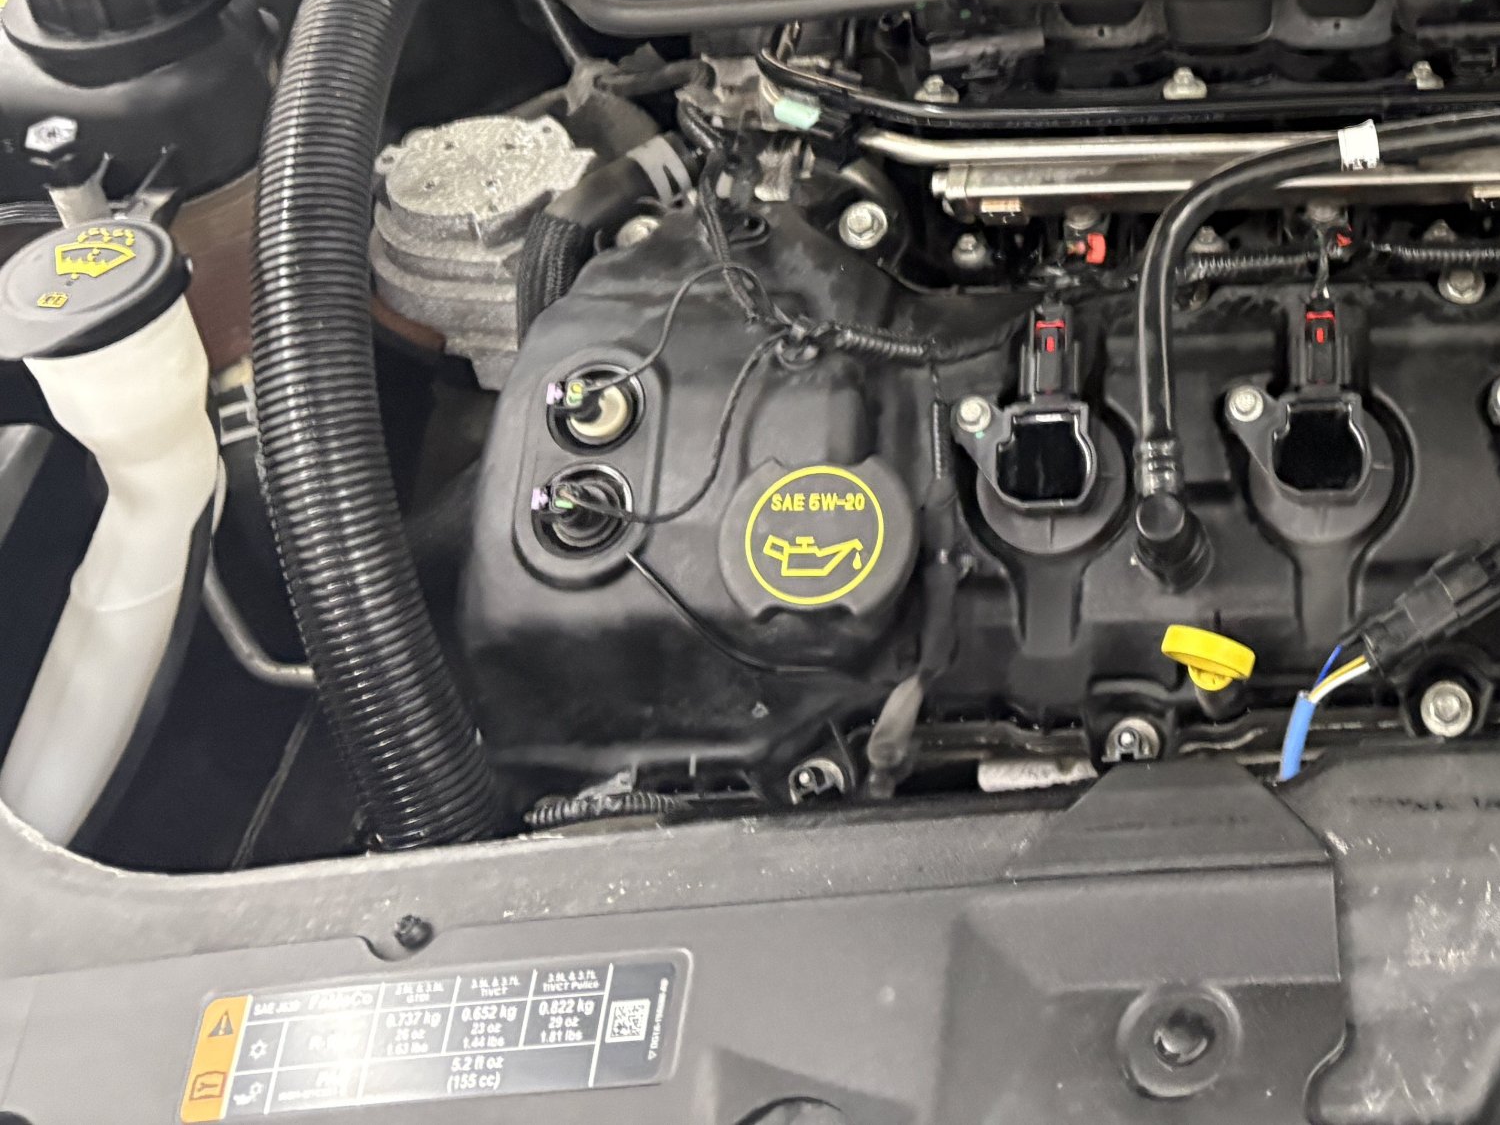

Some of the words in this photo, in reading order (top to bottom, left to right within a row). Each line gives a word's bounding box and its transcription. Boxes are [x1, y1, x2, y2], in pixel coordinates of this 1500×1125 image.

[770, 493, 806, 512] SAE
[809, 492, 866, 511] 5W-20
[461, 1007, 497, 1022] 0.652
[500, 1005, 518, 1021] kg
[539, 1001, 574, 1017] 0.822
[577, 998, 595, 1015] kg
[424, 1010, 441, 1027] kg
[548, 1017, 563, 1029] 29
[564, 1016, 580, 1027] oz
[470, 1023, 485, 1035] 23
[487, 1022, 501, 1034] oz
[565, 1029, 583, 1041] lbs
[487, 1035, 505, 1048] lbs
[451, 1057, 472, 1071] 5.2
[486, 1056, 505, 1070] oz
[447, 1074, 478, 1093] (155
[479, 1071, 501, 1091] cc)
